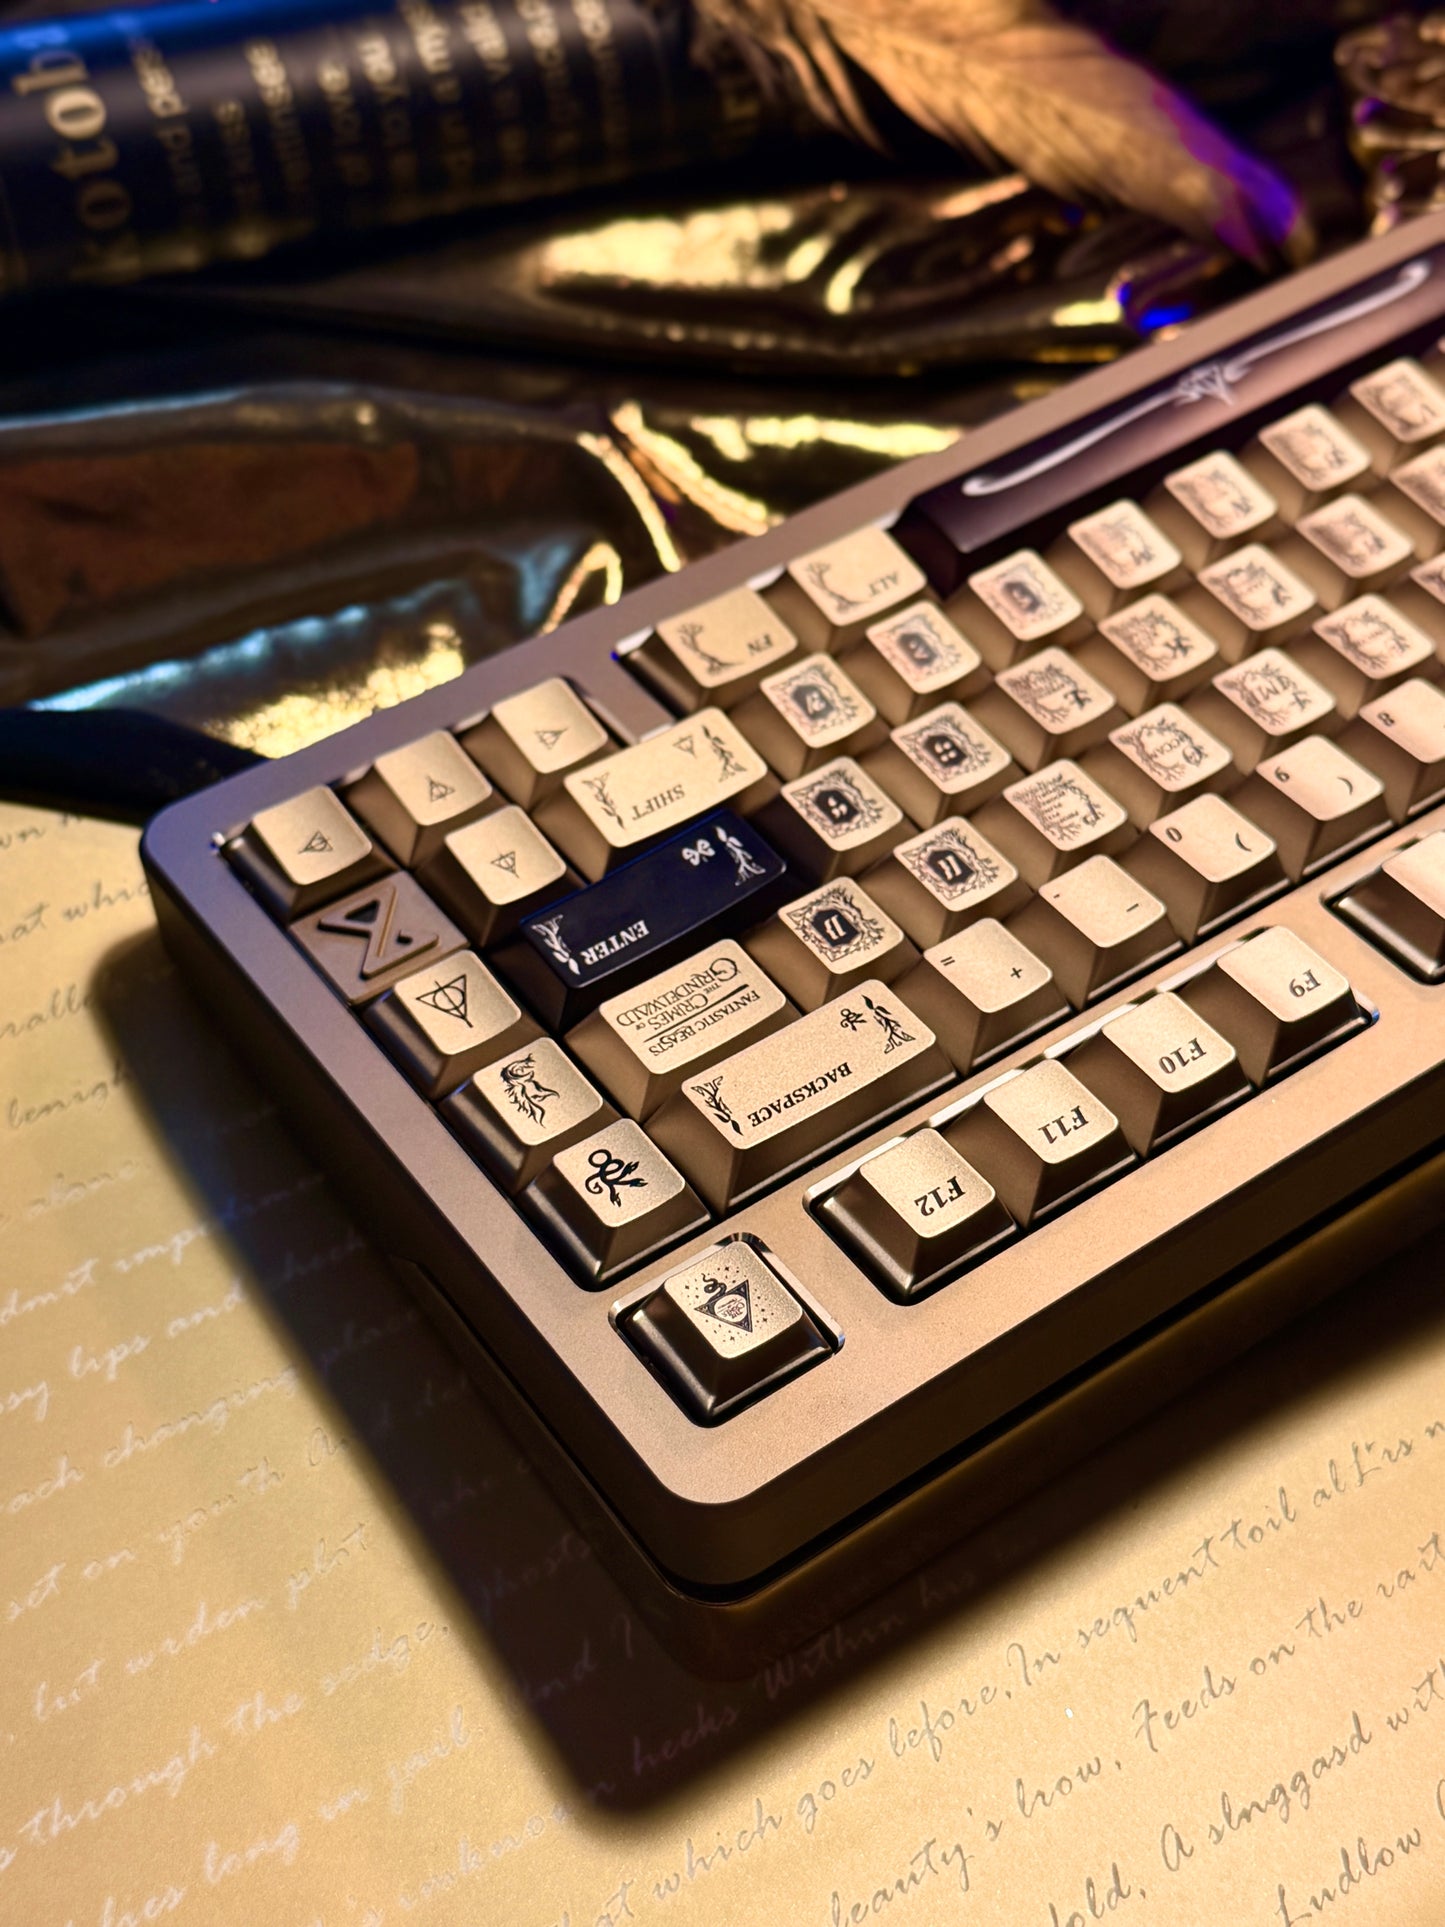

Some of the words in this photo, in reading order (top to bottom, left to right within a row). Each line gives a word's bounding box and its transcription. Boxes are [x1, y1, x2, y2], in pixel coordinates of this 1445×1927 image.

[867, 570, 900, 599] ALT
[747, 633, 773, 655] FN
[632, 784, 686, 821] SHIFT
[579, 920, 650, 967] ENTER
[616, 957, 739, 1027] GRINDELWALD
[703, 982, 721, 996] THE
[1288, 968, 1322, 999] F9
[653, 993, 709, 1031] CRIMES
[698, 990, 761, 1031] FANTASTIC
[648, 1026, 696, 1057] BEASTS
[1158, 1036, 1208, 1075] F10
[747, 1062, 853, 1128] BACKSPACE
[1037, 1104, 1091, 1145] F11
[913, 1175, 967, 1218] F12
[1248, 1642, 1296, 1676] on
[1296, 1596, 1364, 1639] the
[653, 1796, 783, 1901] which
[796, 1757, 876, 1835] goes
